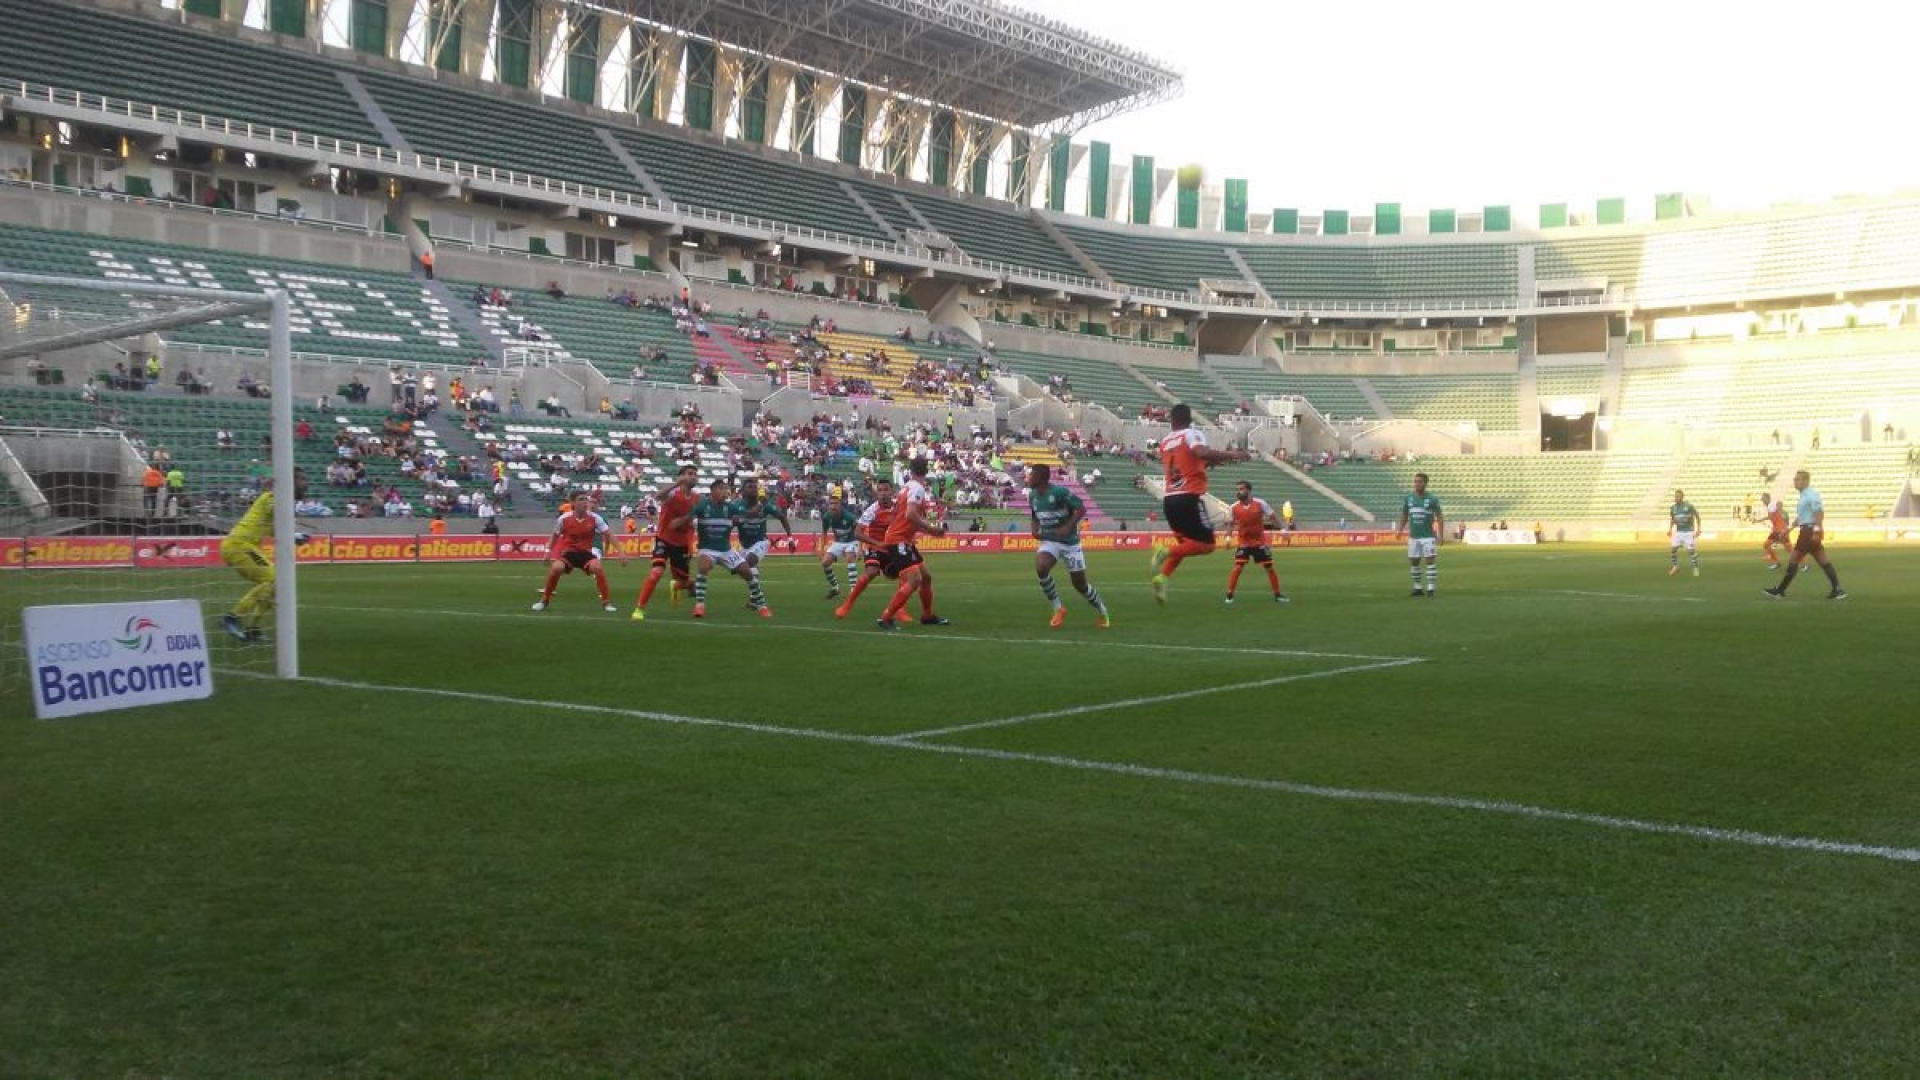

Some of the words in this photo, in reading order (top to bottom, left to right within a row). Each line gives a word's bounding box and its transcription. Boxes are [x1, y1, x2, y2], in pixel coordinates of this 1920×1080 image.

[370, 543, 401, 558] en
[402, 539, 494, 558] caliente
[915, 536, 957, 549] aliente
[166, 633, 200, 651] BBVA
[37, 640, 110, 665] ASCENSO
[38, 660, 204, 705] Bancomer
